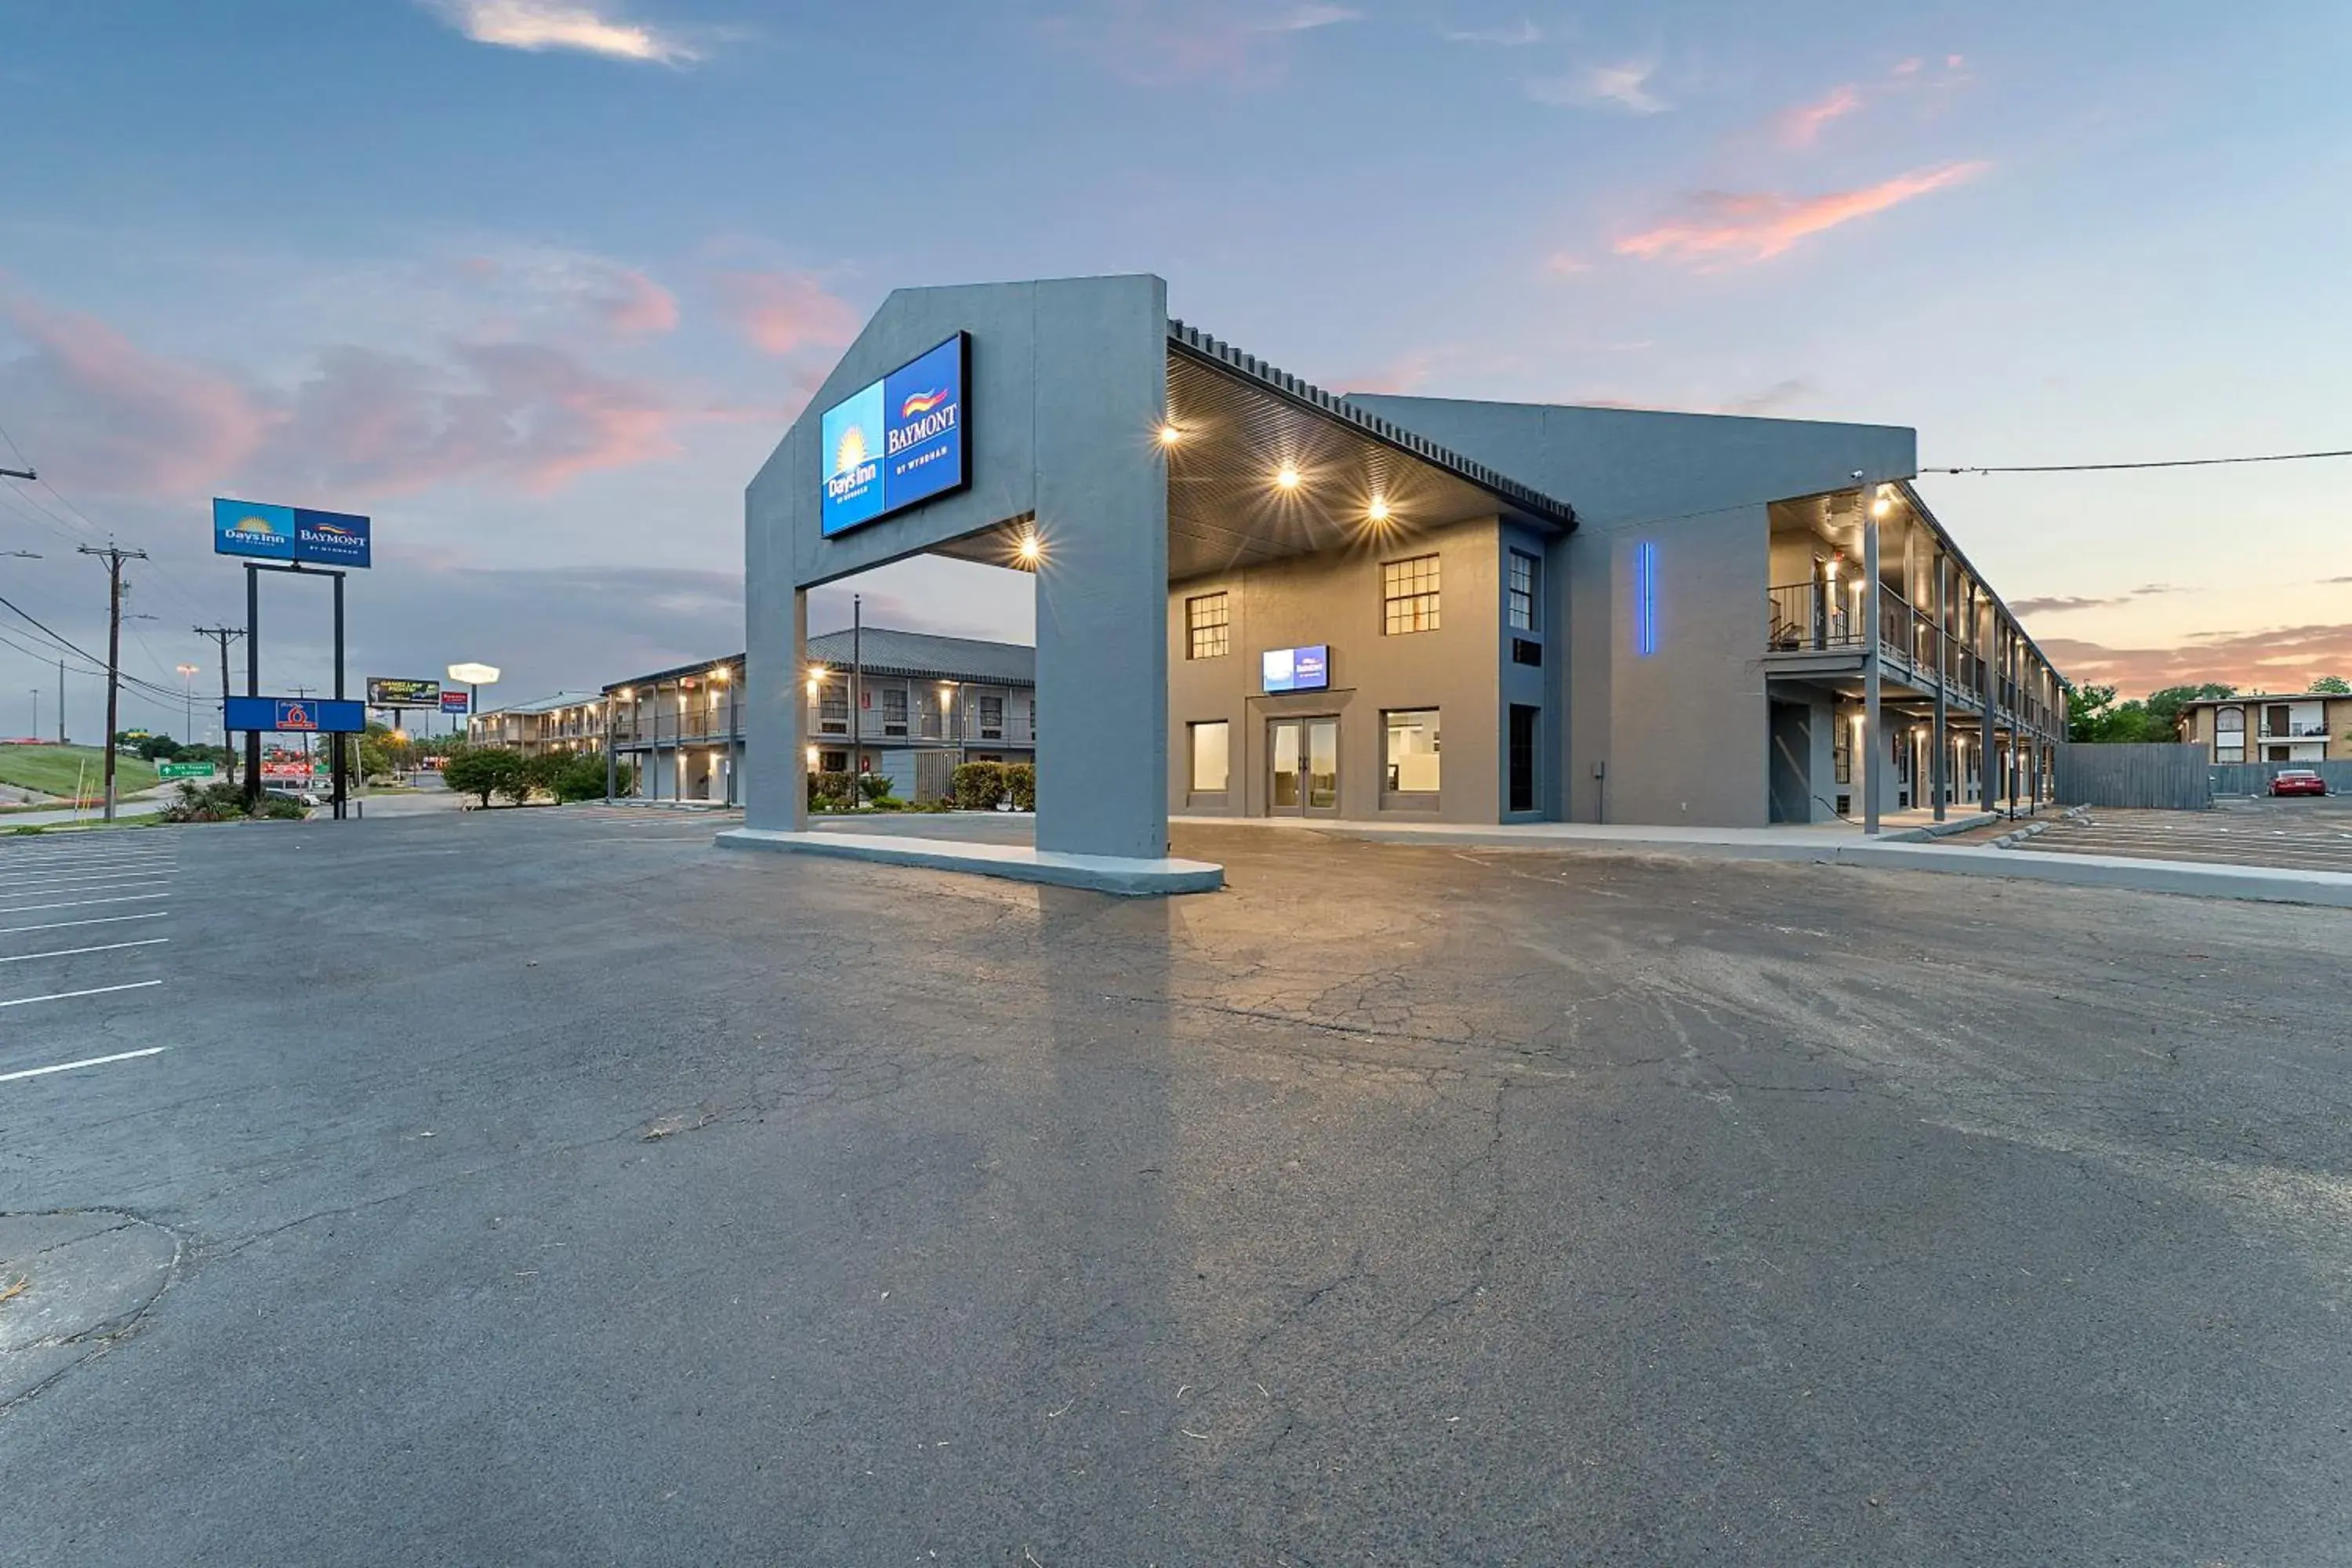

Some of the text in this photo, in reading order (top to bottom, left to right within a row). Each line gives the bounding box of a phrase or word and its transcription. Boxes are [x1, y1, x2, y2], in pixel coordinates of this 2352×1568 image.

[888, 402, 957, 455] BAYMONT
[829, 463, 876, 498] Days Inn
[225, 528, 260, 540] Days
[262, 533, 285, 543] Inn
[300, 529, 365, 546] BAYMONT
